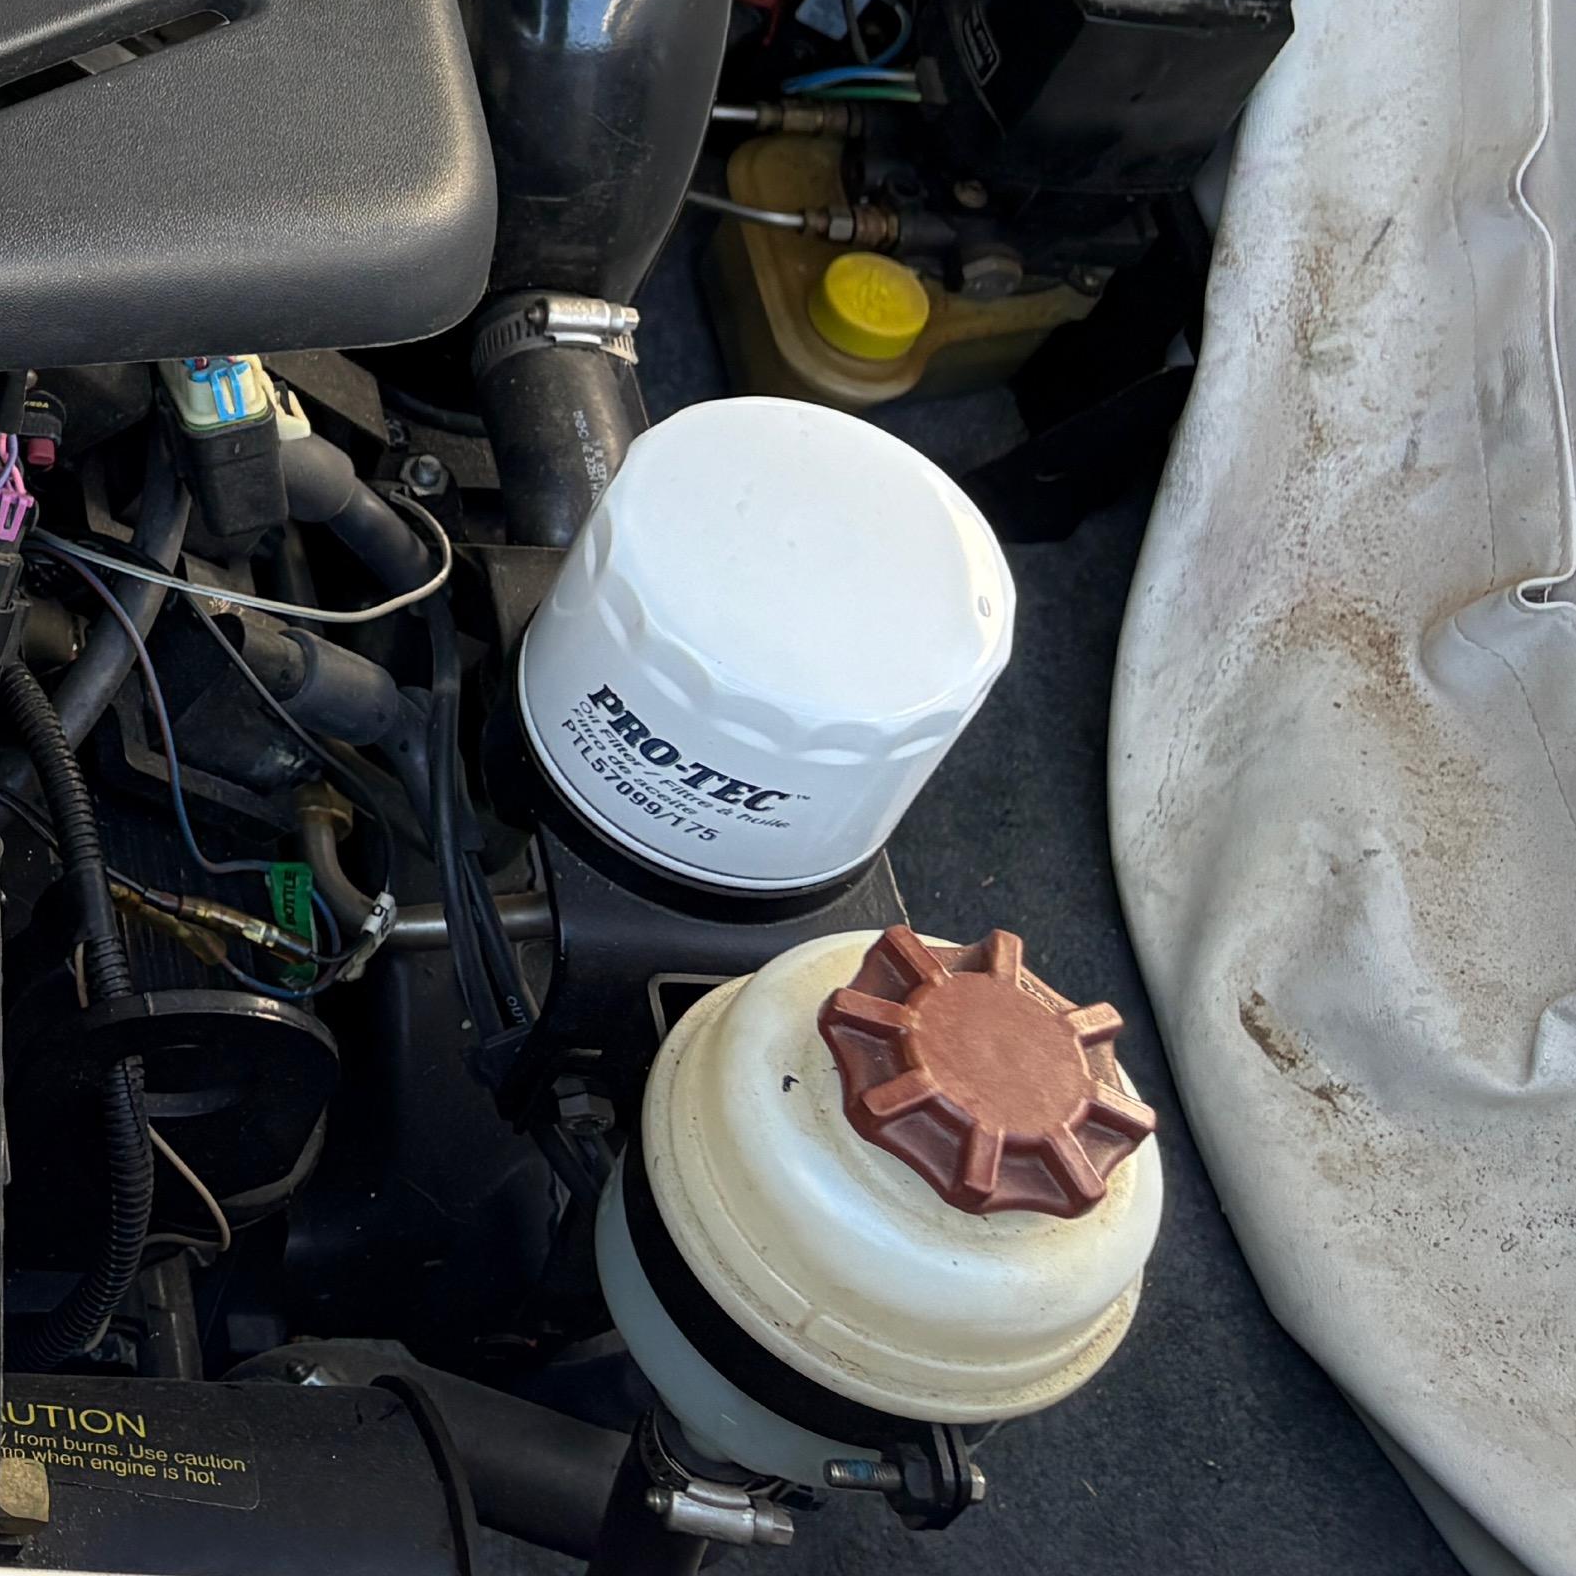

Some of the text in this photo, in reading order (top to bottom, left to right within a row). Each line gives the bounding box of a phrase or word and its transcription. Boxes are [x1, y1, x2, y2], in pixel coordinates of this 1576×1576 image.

[561, 719, 722, 842] PTL57099/175
[571, 707, 700, 816] Filtro de aceite
[579, 700, 601, 724] Oil
[599, 728, 646, 769] Filter
[658, 779, 714, 808] Filtre
[736, 812, 791, 829] huile
[587, 683, 791, 812] PRO-TEC
[506, 995, 528, 1025] OUT
[2, 1401, 146, 1438] UTION
[63, 1436, 123, 1456] burns.
[129, 1443, 169, 1462] Use
[174, 1451, 246, 1473] caution
[32, 1449, 84, 1468] when
[90, 1457, 156, 1478] engine
[163, 1467, 179, 1480] is
[185, 1468, 222, 1487] hot.
